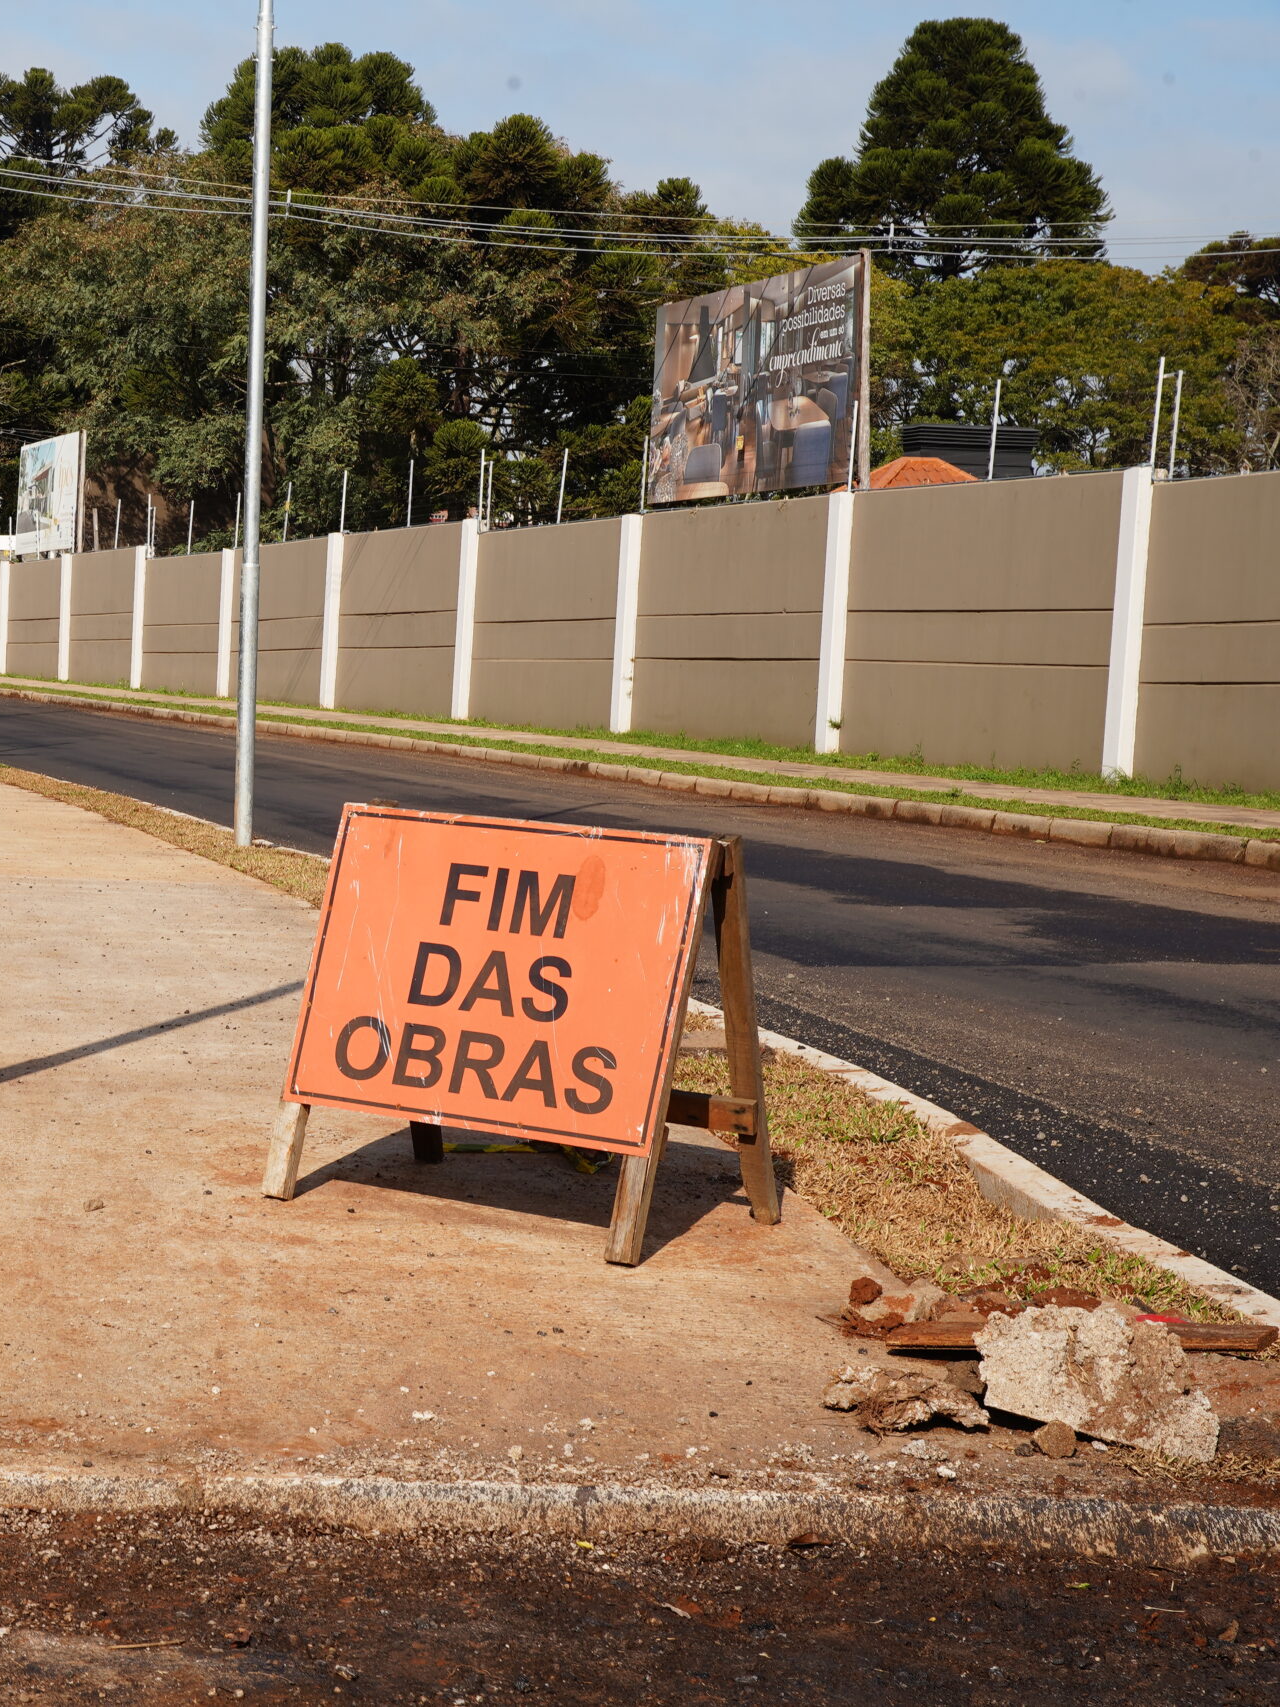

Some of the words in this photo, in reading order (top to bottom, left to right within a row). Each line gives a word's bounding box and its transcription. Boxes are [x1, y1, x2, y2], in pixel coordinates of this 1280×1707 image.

[782, 302, 846, 337] possibilidades
[807, 282, 846, 305] Diversas
[769, 327, 844, 388] empreendimento
[819, 329, 829, 339] em
[829, 328, 838, 337] um
[838, 324, 845, 335] só
[438, 862, 577, 939] FIM
[406, 941, 573, 1023] DAS
[334, 1015, 618, 1115] OBRAS
